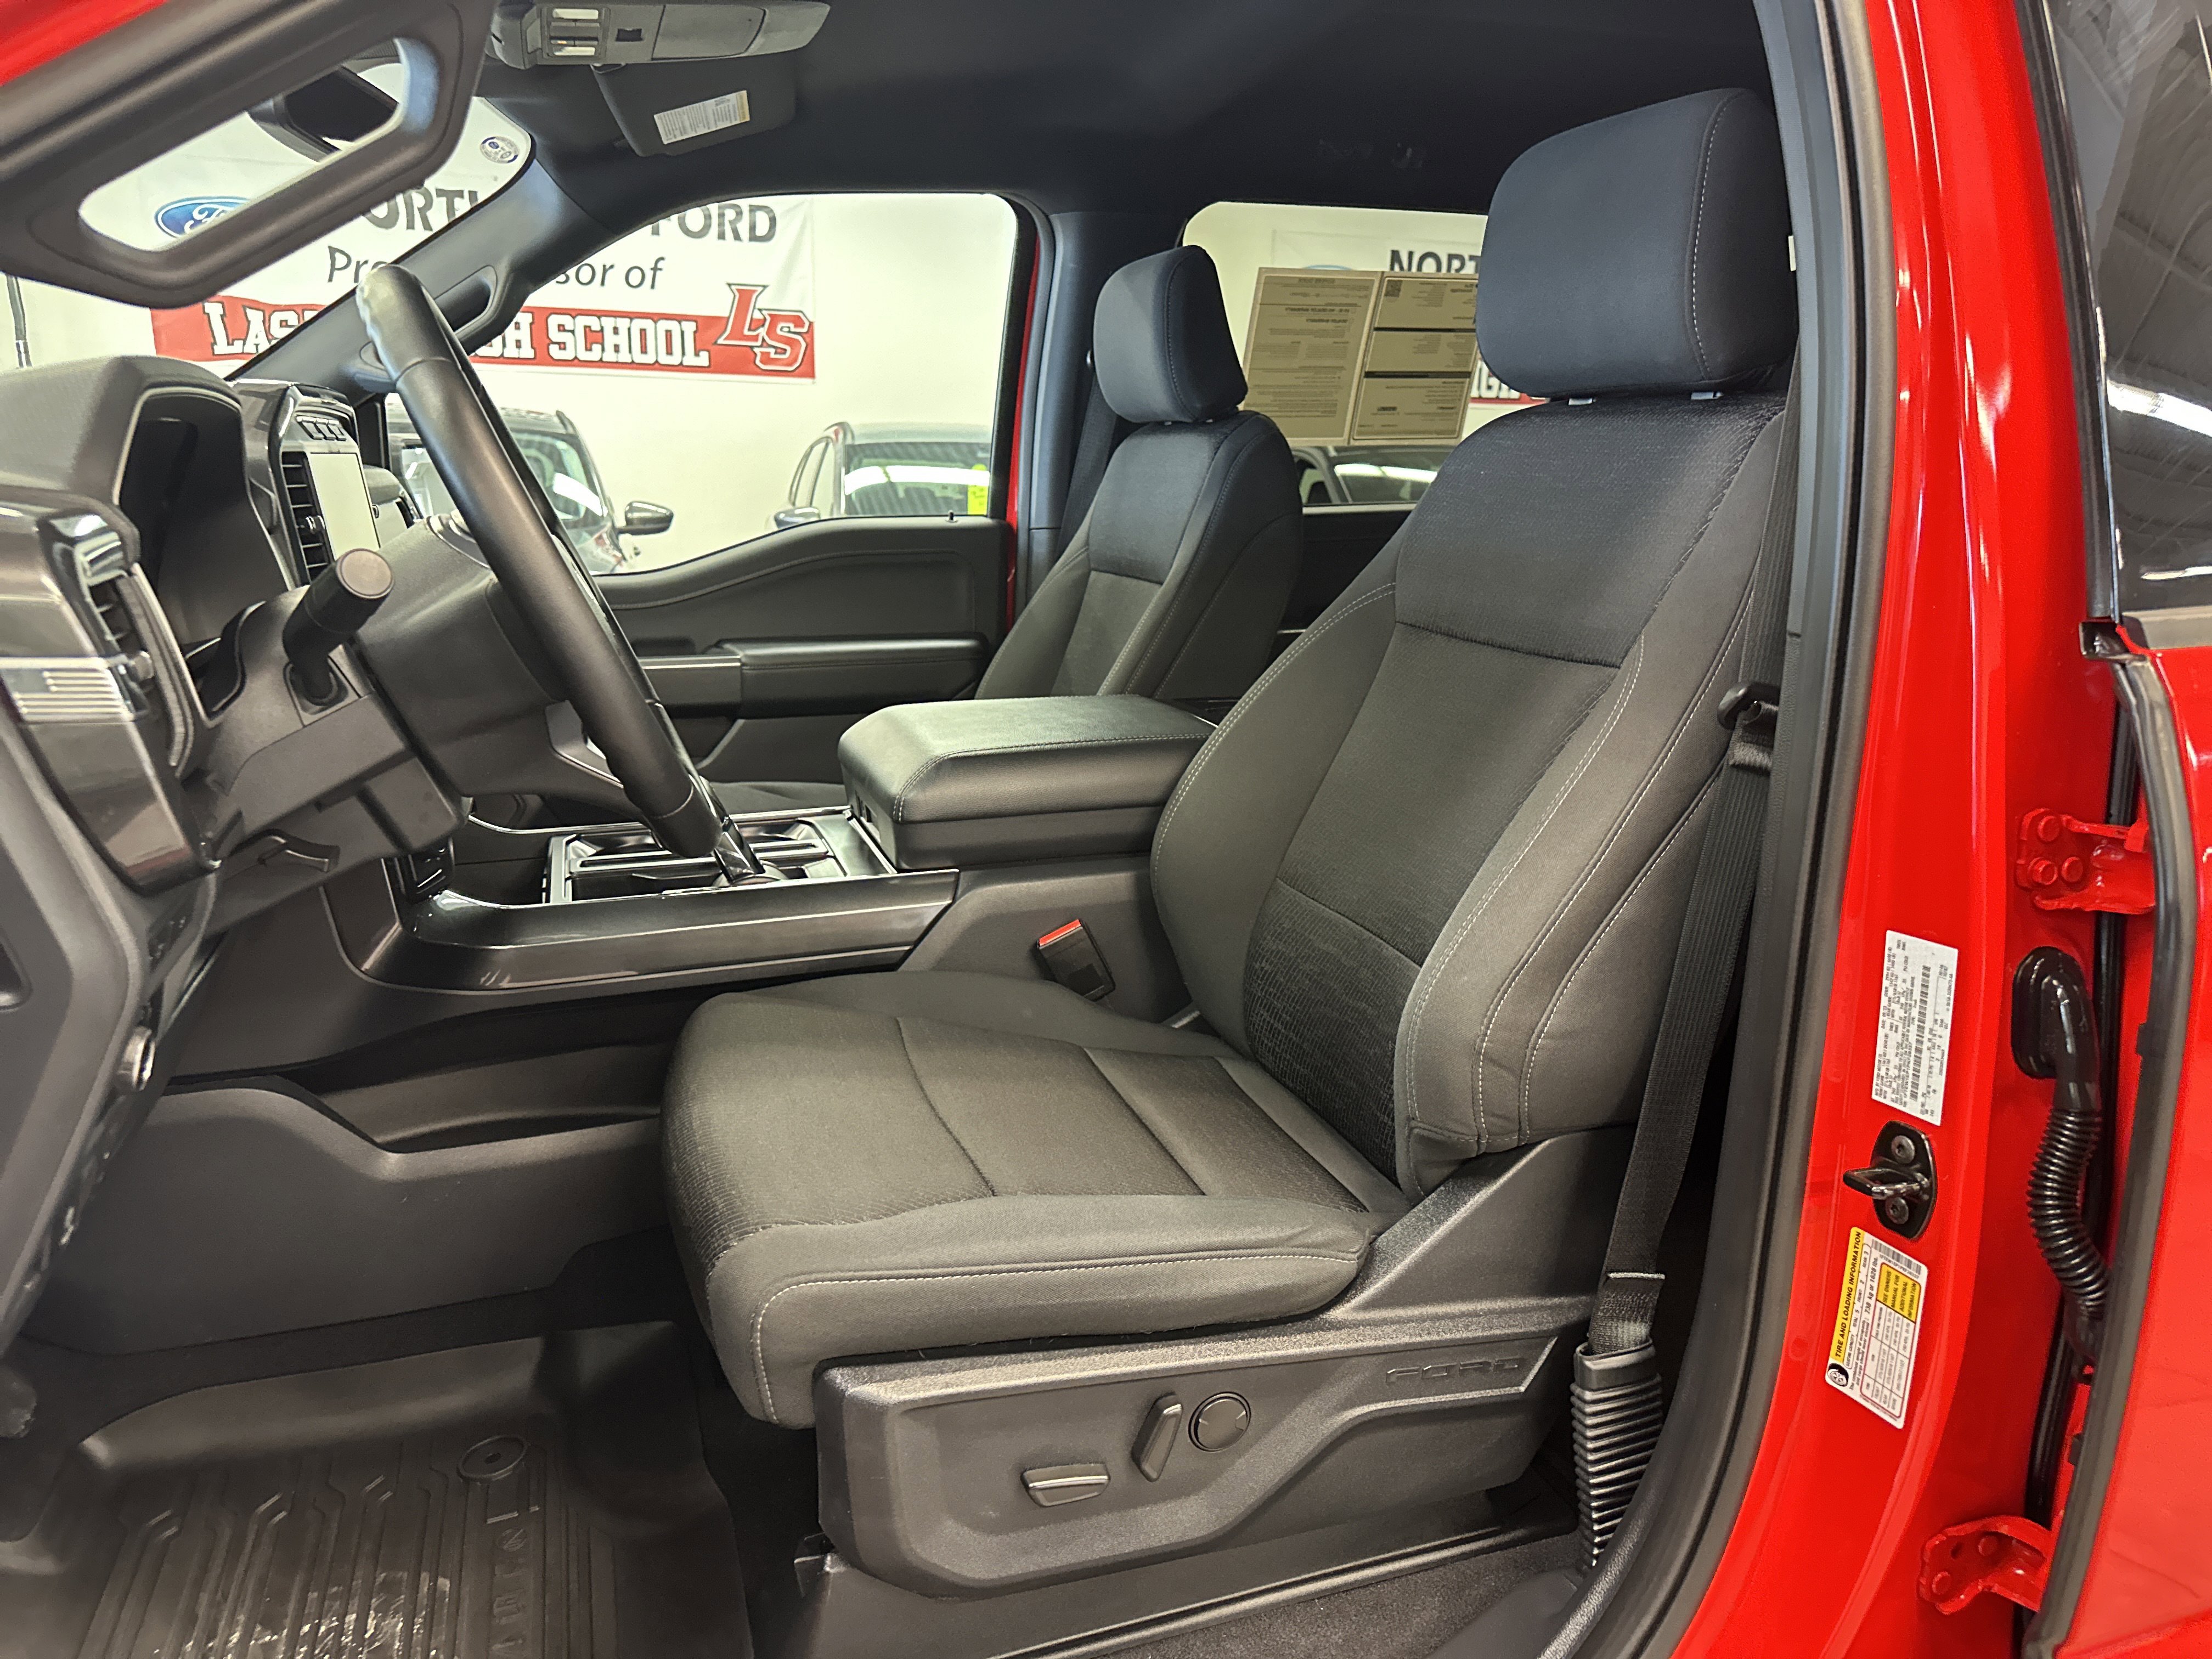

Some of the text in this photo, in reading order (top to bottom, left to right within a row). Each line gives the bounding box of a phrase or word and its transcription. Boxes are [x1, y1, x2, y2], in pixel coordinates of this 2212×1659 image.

[624, 257, 666, 290] of
[547, 313, 710, 368] SCHOOL
[1835, 1230, 1862, 1358] TIRE AND LOADING INFORMATION
[1867, 1290, 1874, 1300] kg
[1385, 1356, 1524, 1384] FORD
